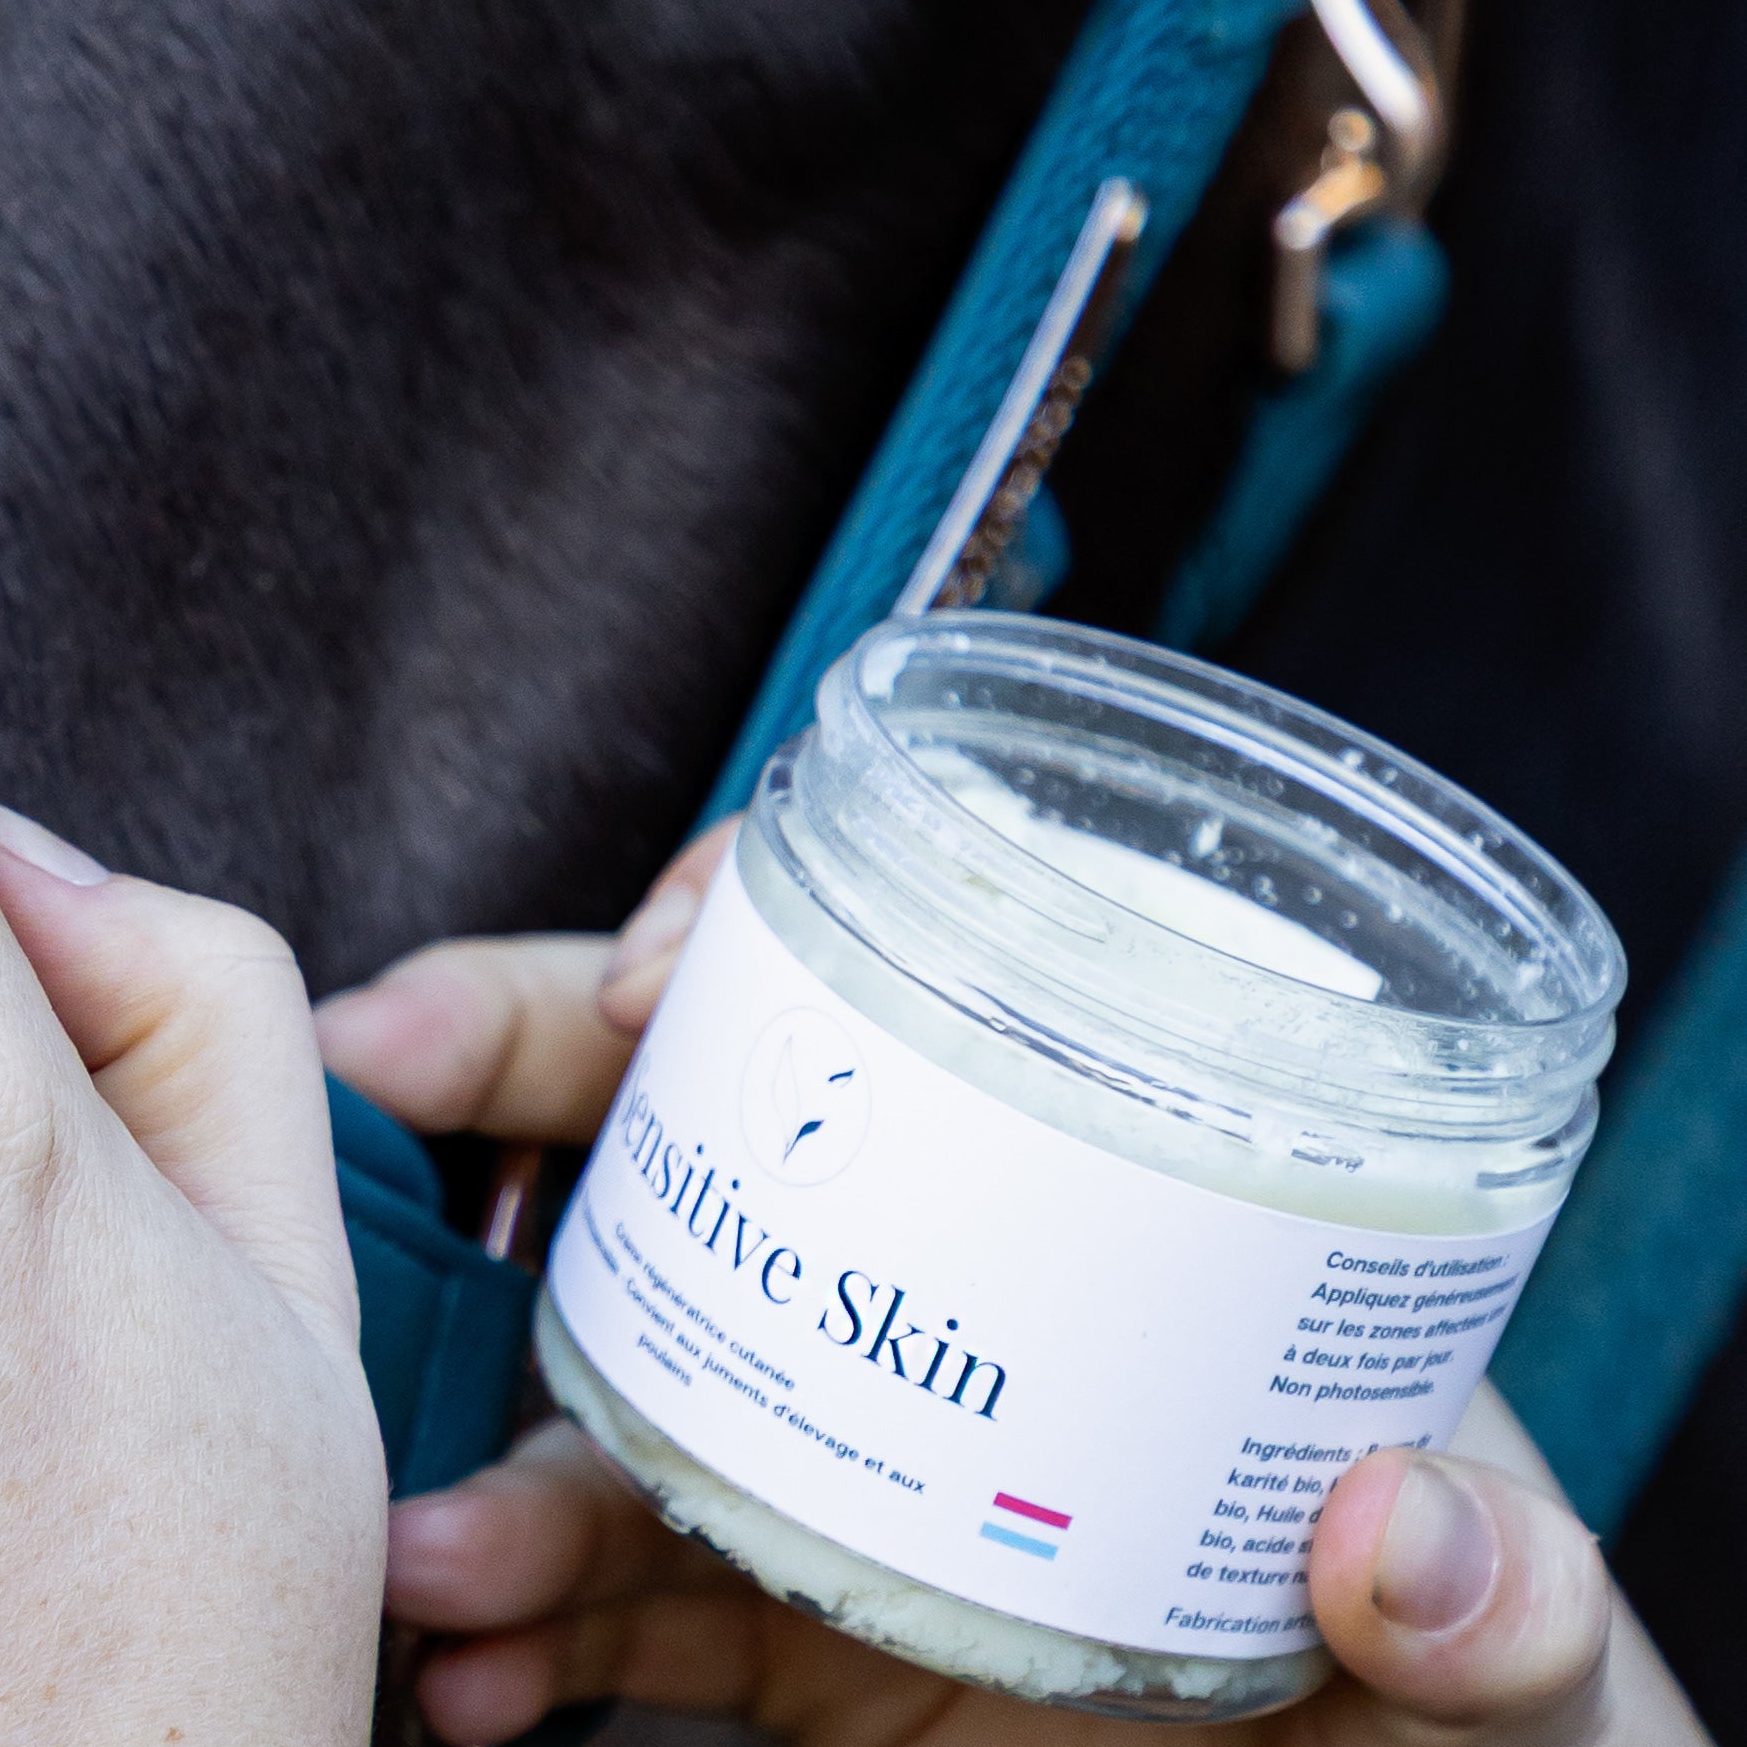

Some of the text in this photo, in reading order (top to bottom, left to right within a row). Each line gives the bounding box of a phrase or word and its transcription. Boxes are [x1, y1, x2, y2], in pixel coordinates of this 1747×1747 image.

[1326, 1250, 1410, 1277] Conseils
[1310, 1282, 1412, 1311] Appliquez
[1297, 1317, 1334, 1334] sur
[1336, 1318, 1366, 1338] les
[1368, 1323, 1423, 1340] zones
[636, 1332, 694, 1387] poulains
[816, 1270, 1009, 1422] Skin
[1283, 1343, 1296, 1362] à
[1302, 1347, 1353, 1370] deux
[1356, 1352, 1388, 1372] fois
[1390, 1354, 1423, 1375] par
[729, 1339, 796, 1391] cutanée
[1269, 1374, 1312, 1398] Non
[675, 1331, 702, 1358] aux
[701, 1353, 769, 1408] juments
[772, 1403, 860, 1460] d'élevage
[864, 1455, 885, 1476] et
[888, 1468, 927, 1495] aux
[1240, 1437, 1352, 1463] Ingrédients
[1227, 1467, 1289, 1492] karité
[1292, 1473, 1325, 1497] bio,
[1213, 1498, 1250, 1524] bio,
[1255, 1504, 1306, 1525] Huile
[1199, 1528, 1238, 1554] bio,
[1241, 1534, 1296, 1555] acide
[1185, 1560, 1214, 1580] de
[1217, 1564, 1290, 1587] texture
[1163, 1605, 1281, 1635] Fabrication
